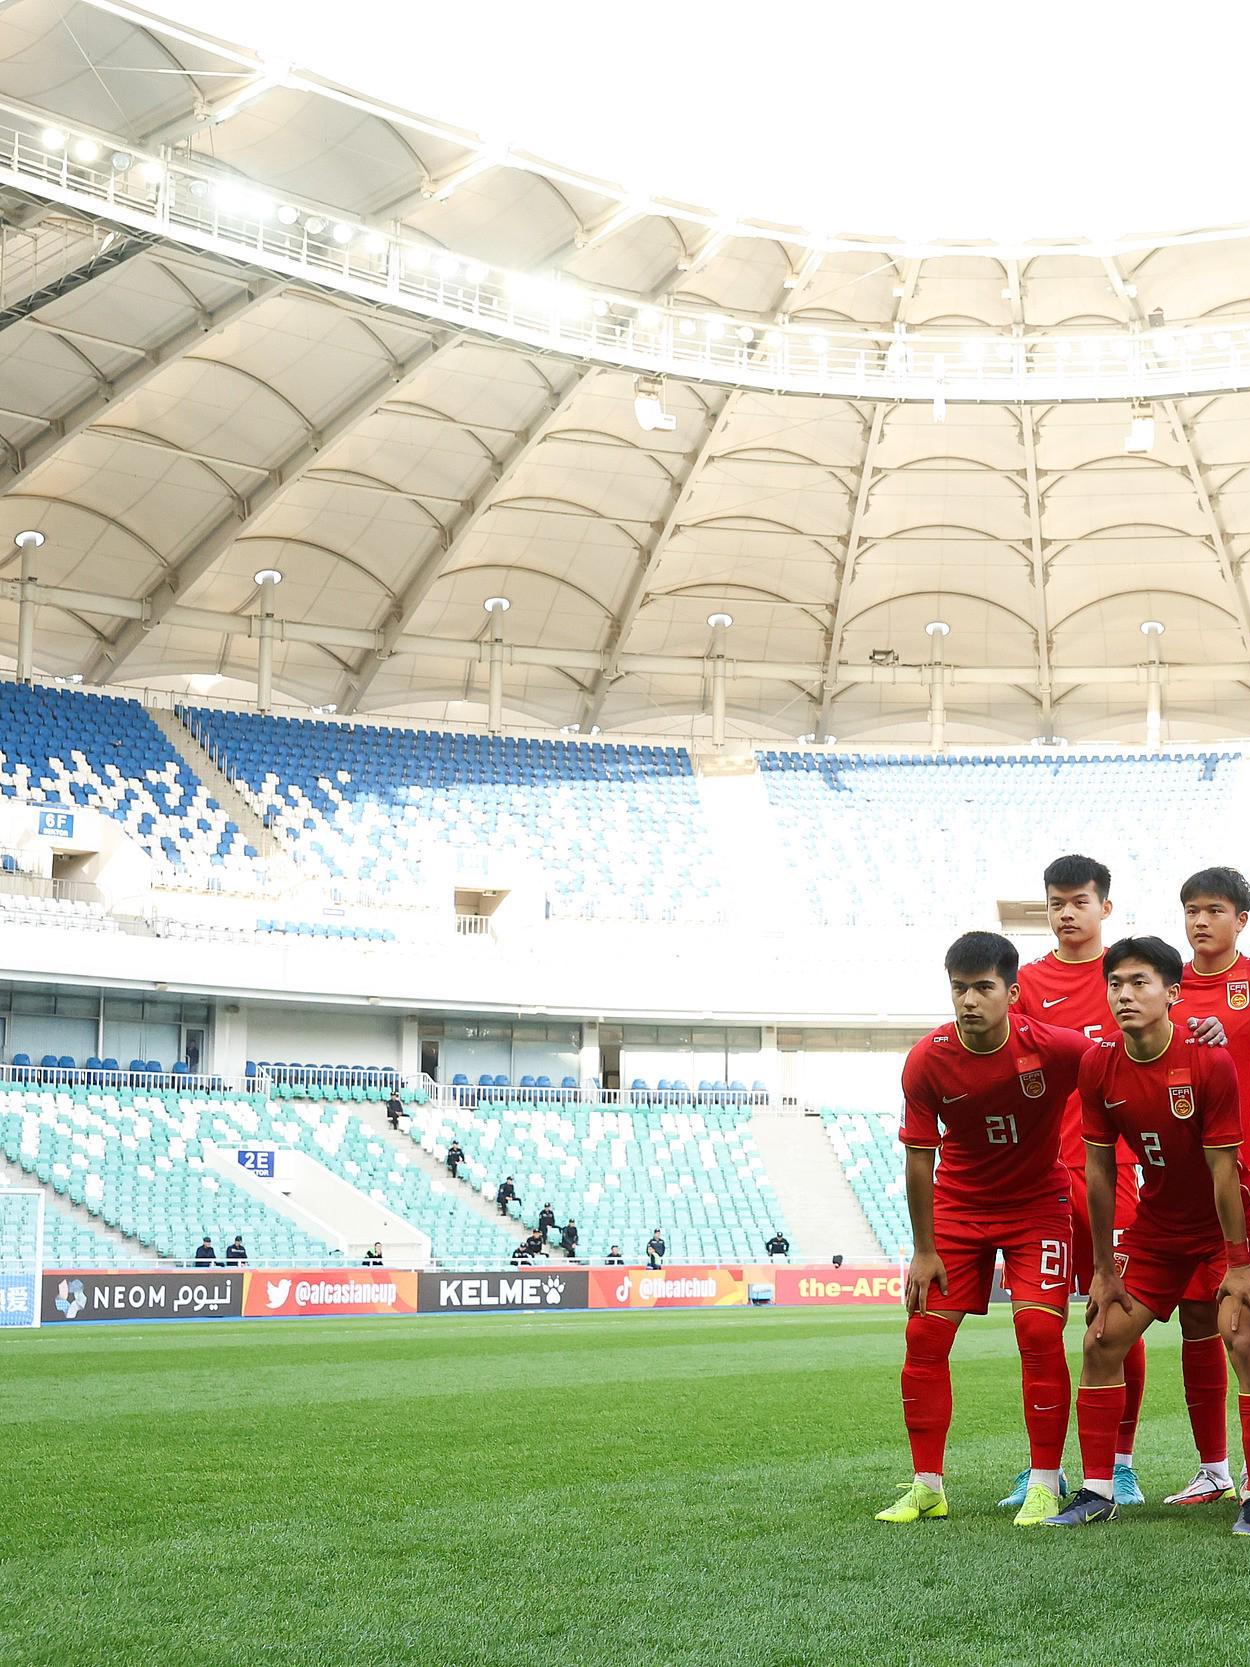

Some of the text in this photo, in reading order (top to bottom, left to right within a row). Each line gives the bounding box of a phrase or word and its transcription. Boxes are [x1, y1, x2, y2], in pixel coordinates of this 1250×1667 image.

[45, 813, 68, 829] 6F
[985, 1114, 1018, 1144] 21
[244, 1152, 269, 1169] 2E
[1140, 1132, 1166, 1167] 2
[1040, 1240, 1067, 1278] 21
[93, 1285, 166, 1309] NEOM
[173, 1280, 231, 1312] نيوم
[295, 1281, 397, 1306] @afcasiancup
[440, 1279, 541, 1306] KELME
[639, 1277, 717, 1300] @theafchub
